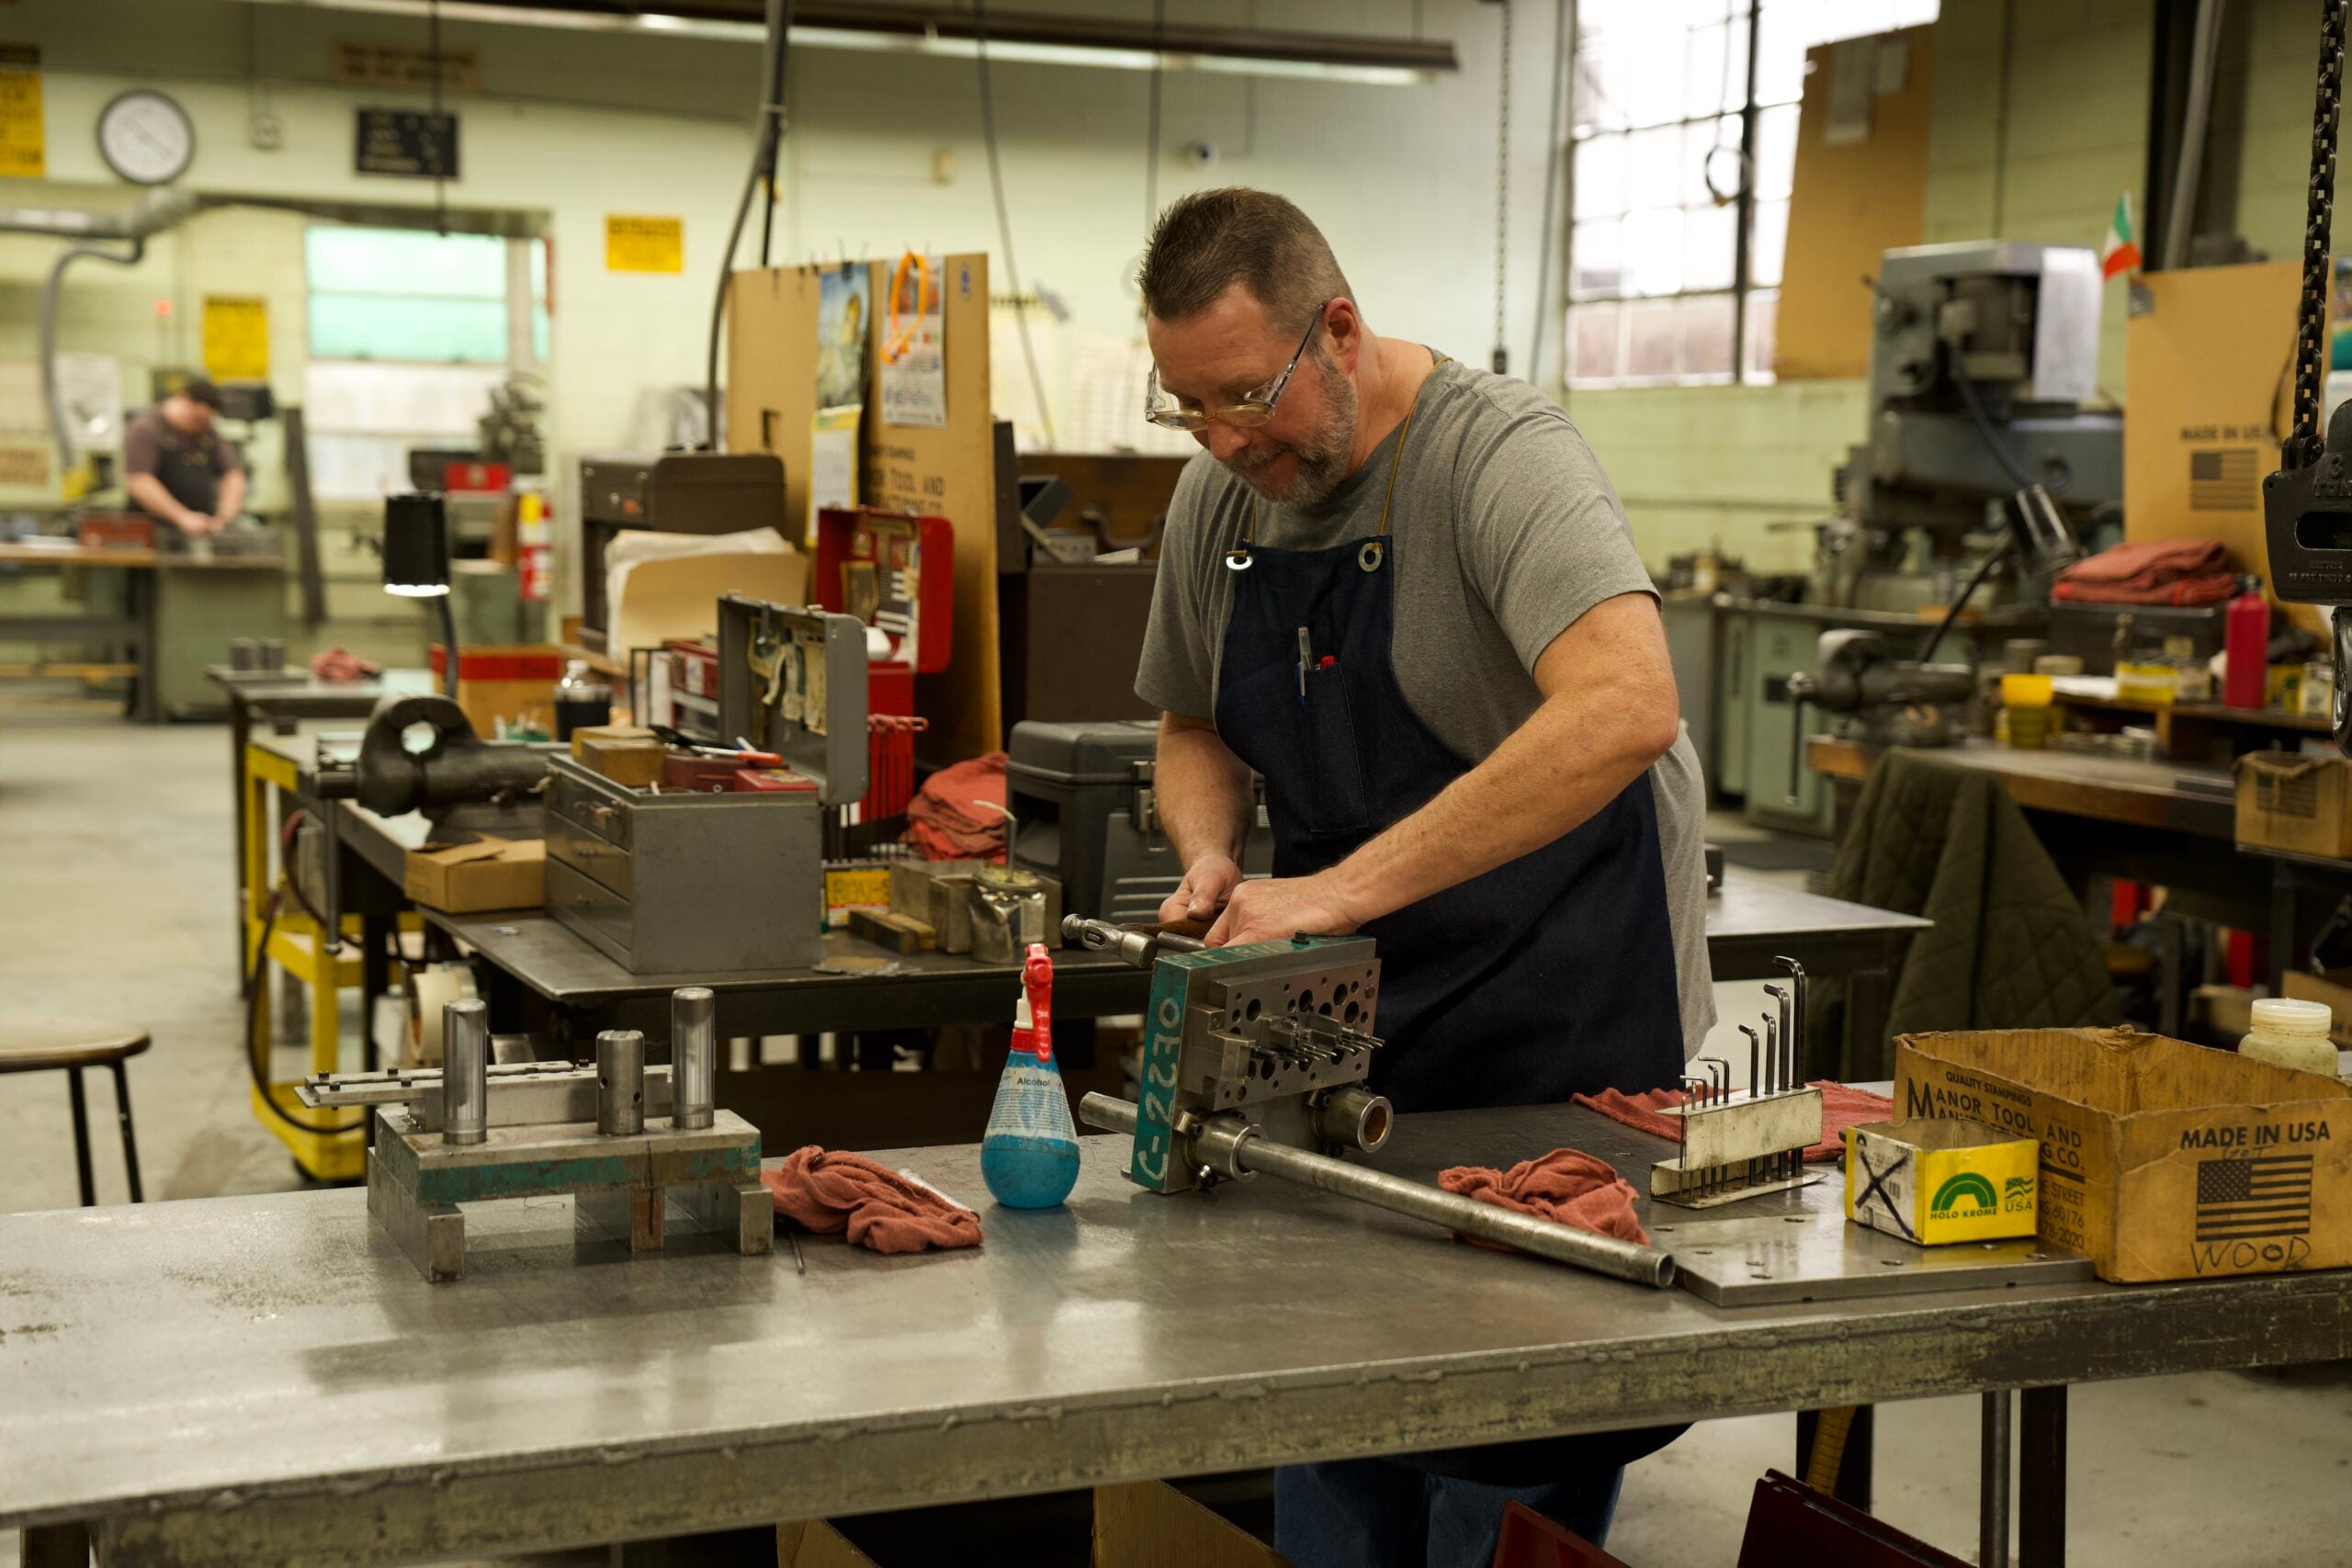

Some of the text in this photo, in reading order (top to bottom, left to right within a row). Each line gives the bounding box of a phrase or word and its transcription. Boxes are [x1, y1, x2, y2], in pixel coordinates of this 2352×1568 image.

[1017, 1077, 1050, 1087] Alcohol
[1946, 1071, 2033, 1108] QUALITY STAMPINGS
[1907, 1077, 1982, 1119] MANOR
[1992, 1102, 2035, 1133] TOOL
[2046, 1123, 2082, 1148] AND
[2180, 1121, 2331, 1149] MADE IN USA
[2057, 1145, 2086, 1171] CO.
[2052, 1182, 2085, 1206] STREET
[1929, 1208, 1997, 1221] HOLO KROME
[2005, 1201, 2033, 1213] USA
[2052, 1205, 2085, 1228] 60176
[2190, 1235, 2312, 1274] WOOD
